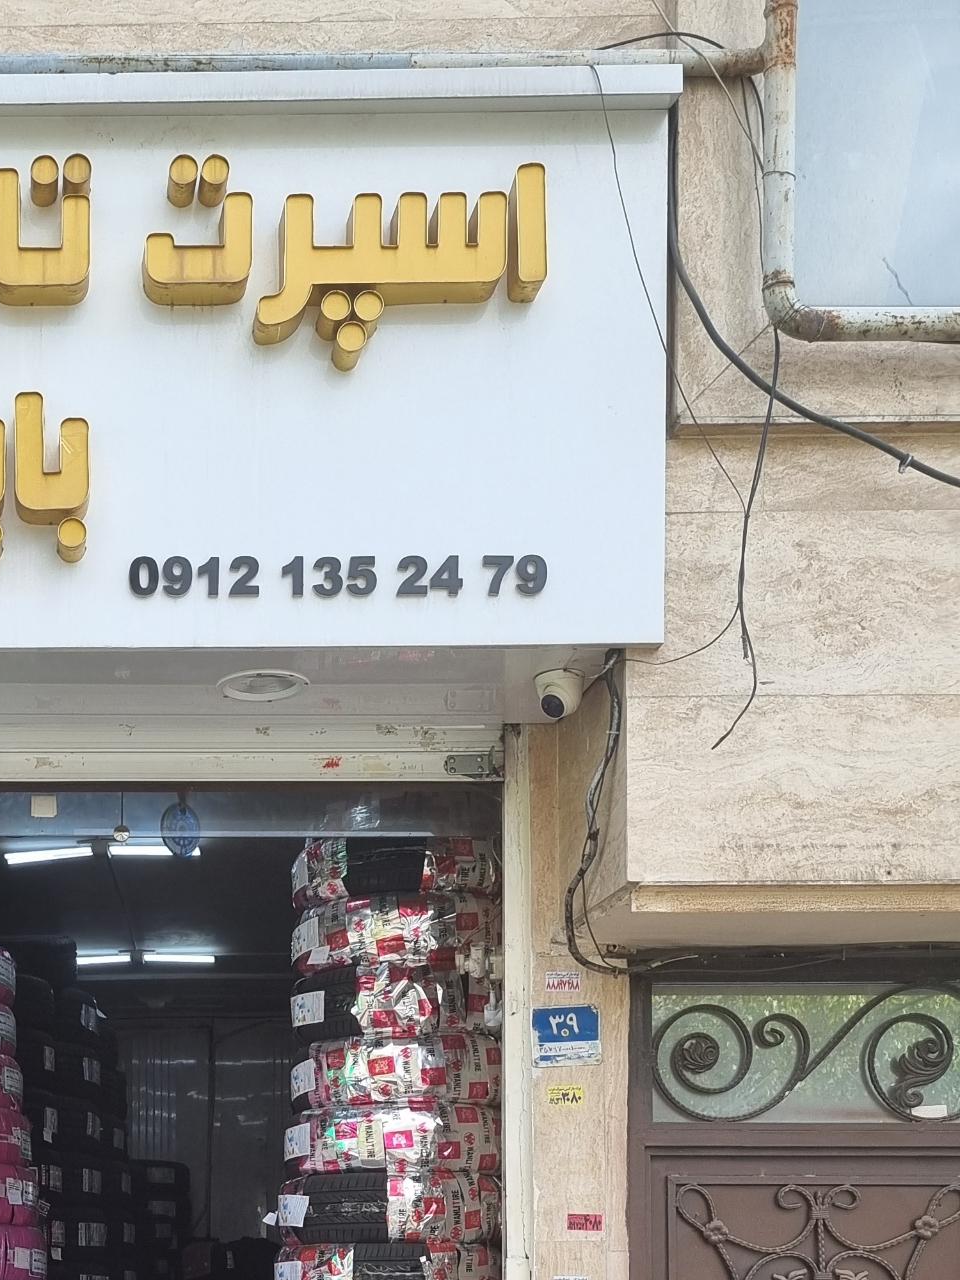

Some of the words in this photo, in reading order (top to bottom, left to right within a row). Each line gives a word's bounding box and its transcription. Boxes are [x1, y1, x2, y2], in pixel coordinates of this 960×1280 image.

[142, 153, 547, 372] اسپرت
[128, 554, 260, 598] 0912
[282, 554, 377, 597] 135
[397, 554, 463, 597] 24
[482, 554, 549, 597] 79
[364, 1123, 376, 1159] WANLITIRE
[451, 1189, 462, 1226] WANLITIRE
